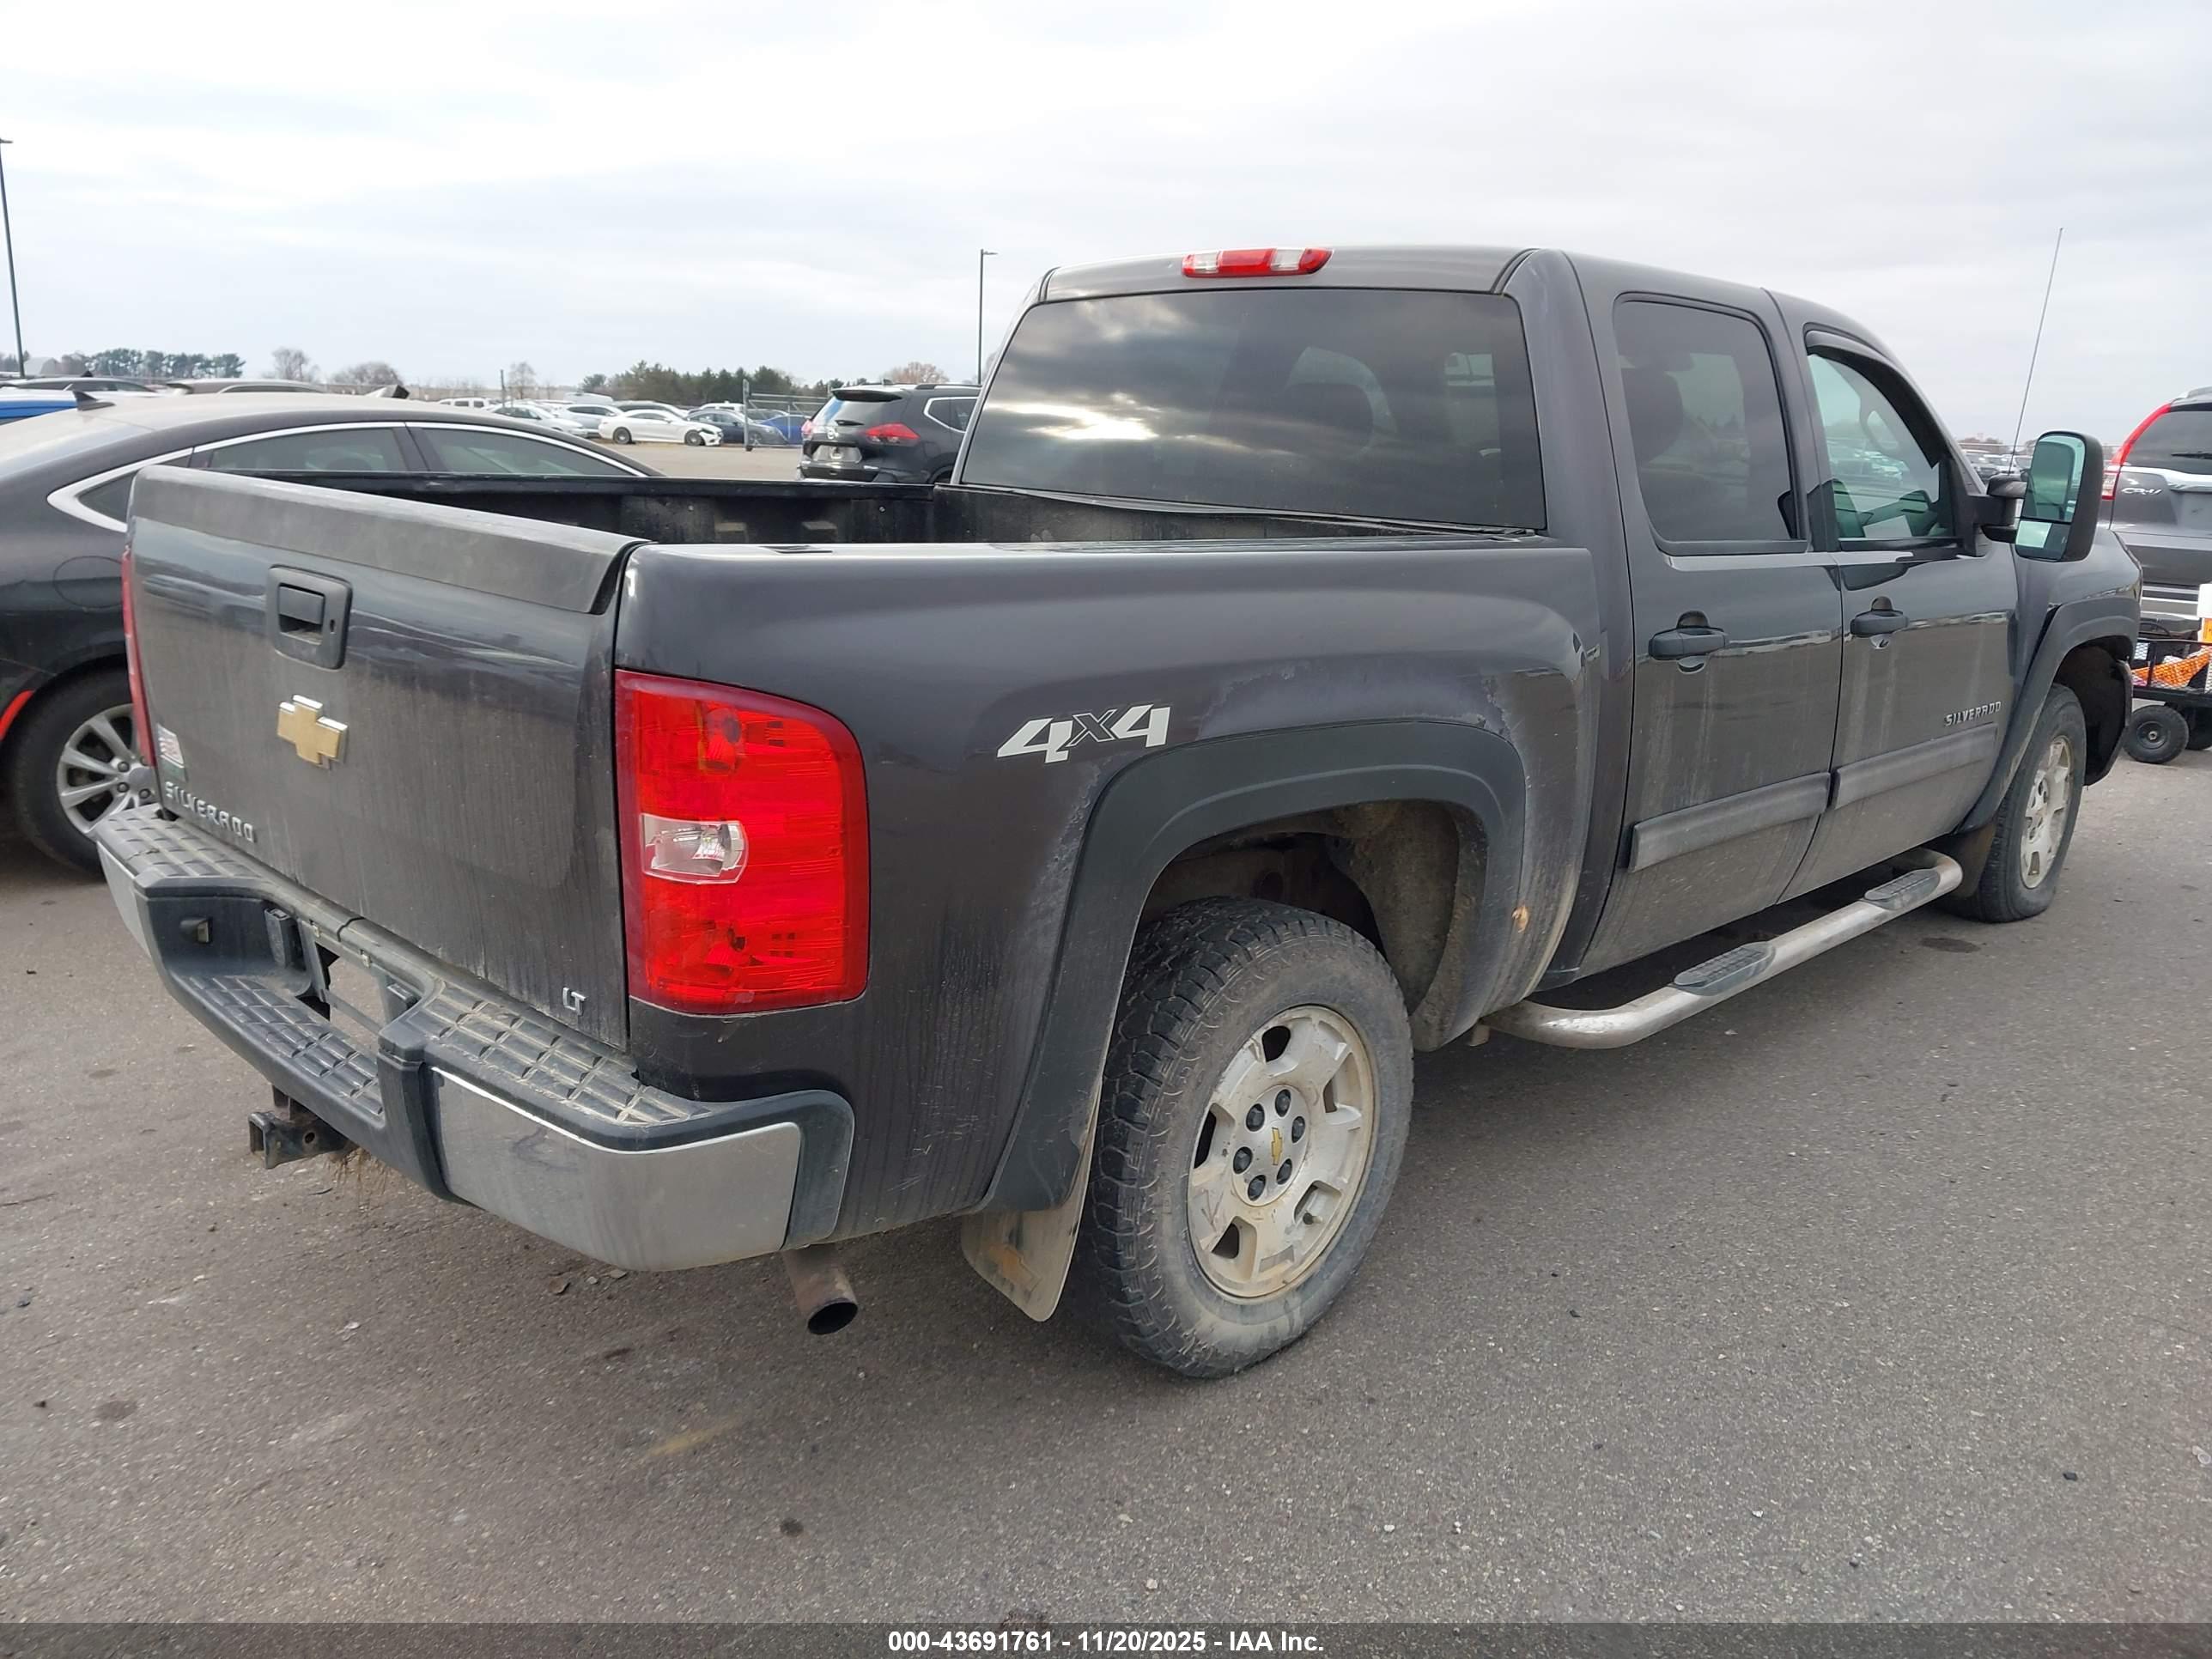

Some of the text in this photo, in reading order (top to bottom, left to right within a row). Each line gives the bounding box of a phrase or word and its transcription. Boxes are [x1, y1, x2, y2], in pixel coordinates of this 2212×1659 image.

[1944, 701, 2002, 726] SILVERADO
[165, 781, 256, 843] SILVERADO
[562, 987, 586, 1016] LT
